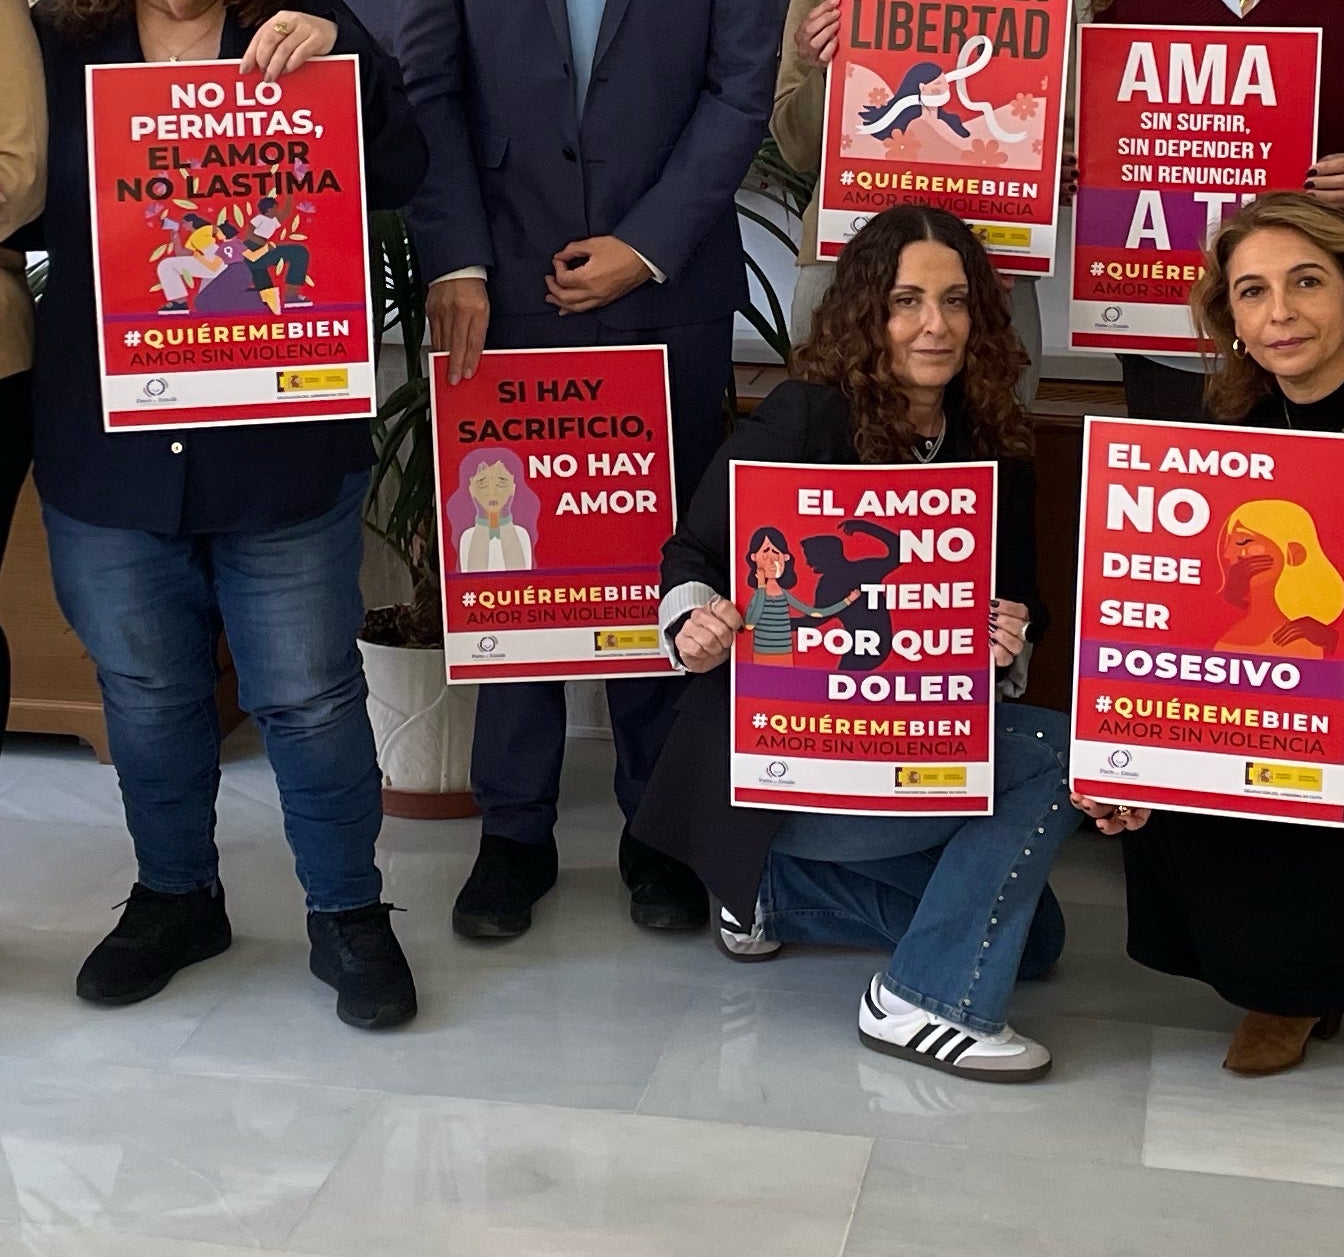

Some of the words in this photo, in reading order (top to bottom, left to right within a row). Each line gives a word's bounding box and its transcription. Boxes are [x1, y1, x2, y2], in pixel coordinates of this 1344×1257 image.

[850, 0, 1050, 60] LIBERTAD
[1116, 41, 1277, 106] AMA
[170, 83, 225, 109] NO
[236, 82, 282, 106] LO
[130, 110, 324, 141] PERMITAS,
[1140, 112, 1172, 130] SIN
[1177, 114, 1251, 135] SUFRIR,
[148, 146, 190, 170] EL
[201, 141, 310, 167] AMOR
[1118, 138, 1149, 157] SIN
[1156, 139, 1254, 159] DEPENDER
[1260, 142, 1272, 159] Y
[116, 177, 174, 202] NO
[187, 170, 342, 199] LASTIMA
[840, 170, 1038, 199] #QUIÉREMEBIEN
[1121, 165, 1152, 183] SIN
[1158, 165, 1266, 186] RENUNCIAR
[842, 191, 898, 207] AMOR
[936, 196, 1034, 217] VIOLENCIA
[1125, 190, 1172, 251] A
[1093, 282, 1149, 295] AMOR
[1152, 284, 1183, 297] SIN
[124, 319, 350, 348] #QUIÉREMEBIEN
[130, 348, 196, 367] AMOR
[202, 346, 235, 363] SIN
[240, 342, 348, 361] VIOLENCIA
[497, 381, 526, 403] SI
[537, 379, 604, 402] HAY
[459, 415, 654, 443] SACRIFICIO,
[528, 454, 577, 479] NO
[587, 452, 656, 476] HAY
[1108, 442, 1150, 470] EL
[1159, 447, 1275, 481] AMOR
[555, 490, 657, 516] AMOR
[798, 489, 845, 515] EL
[854, 489, 977, 517] AMOR
[1106, 483, 1211, 537] NO
[899, 527, 976, 563] NO
[1102, 552, 1202, 585] DEBE
[462, 584, 660, 609] #QUIÉREMEBIEN
[861, 582, 975, 610] TIENE
[466, 610, 521, 625] AMOR
[527, 608, 556, 623] SIN
[560, 605, 659, 621] VIOLENCIA
[1099, 600, 1170, 630] SER
[797, 626, 881, 656] POR
[892, 628, 974, 662] QUE
[1098, 647, 1301, 690] POSESIVO
[828, 674, 974, 702] DOLER
[752, 714, 971, 736] #QUIÉREMEBIEN
[1095, 696, 1330, 733] #QUIÉREMEBIEN
[756, 735, 817, 752] AMOR
[821, 736, 855, 753] SIN
[859, 737, 968, 756] VIOLENCIA
[1098, 719, 1163, 740] AMOR
[1169, 726, 1203, 743] SIN
[1209, 731, 1326, 755] VIOLENCIA
